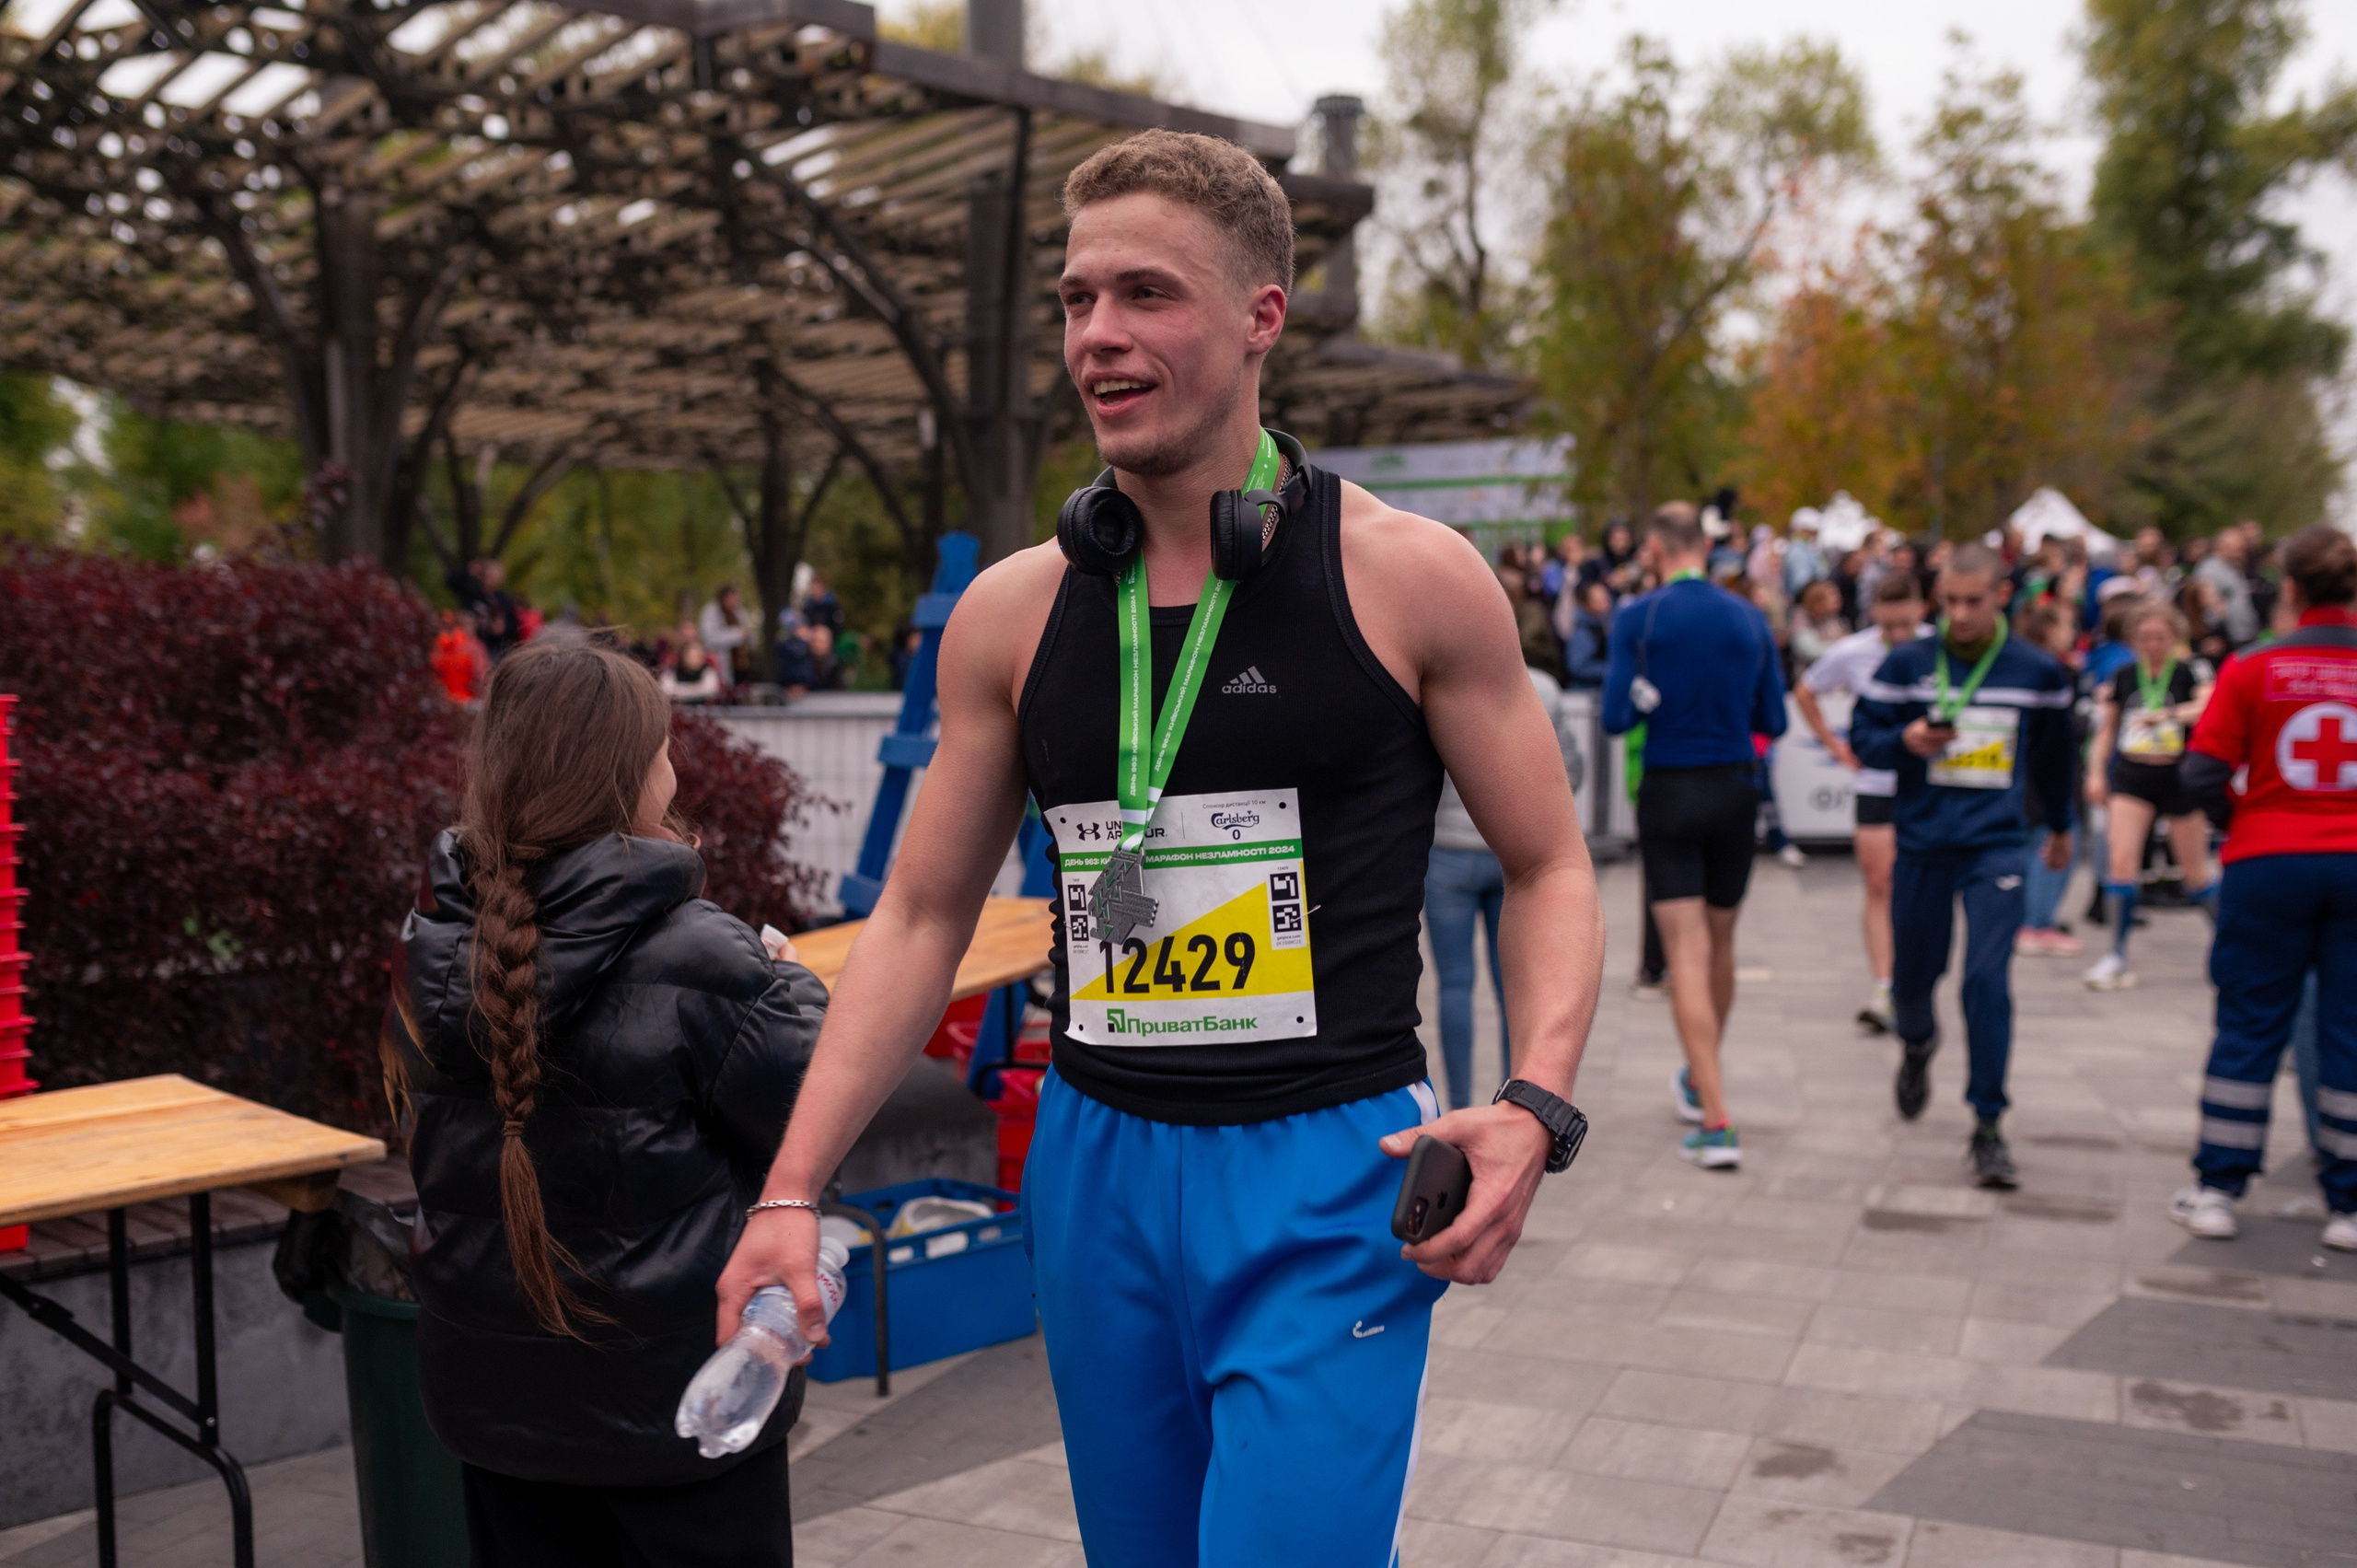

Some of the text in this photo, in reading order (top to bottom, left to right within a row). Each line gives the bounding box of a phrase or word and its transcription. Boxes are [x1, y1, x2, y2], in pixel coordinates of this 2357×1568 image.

[1182, 646, 1200, 686] МАРАФОН
[1196, 592, 1218, 647] НЕЗЛАМНОСТІ
[1221, 682, 1277, 694] adidas
[1211, 810, 1260, 830] Carlsberg
[1064, 858, 1084, 867] ДЕНЬ
[1145, 853, 1193, 864] МАРАФОН
[1195, 848, 1267, 861] НЕЗЛАМНОСТІ
[1268, 844, 1295, 854] 2024
[1099, 932, 1256, 994] 12429
[1127, 1016, 1258, 1037] ПриватБанк
